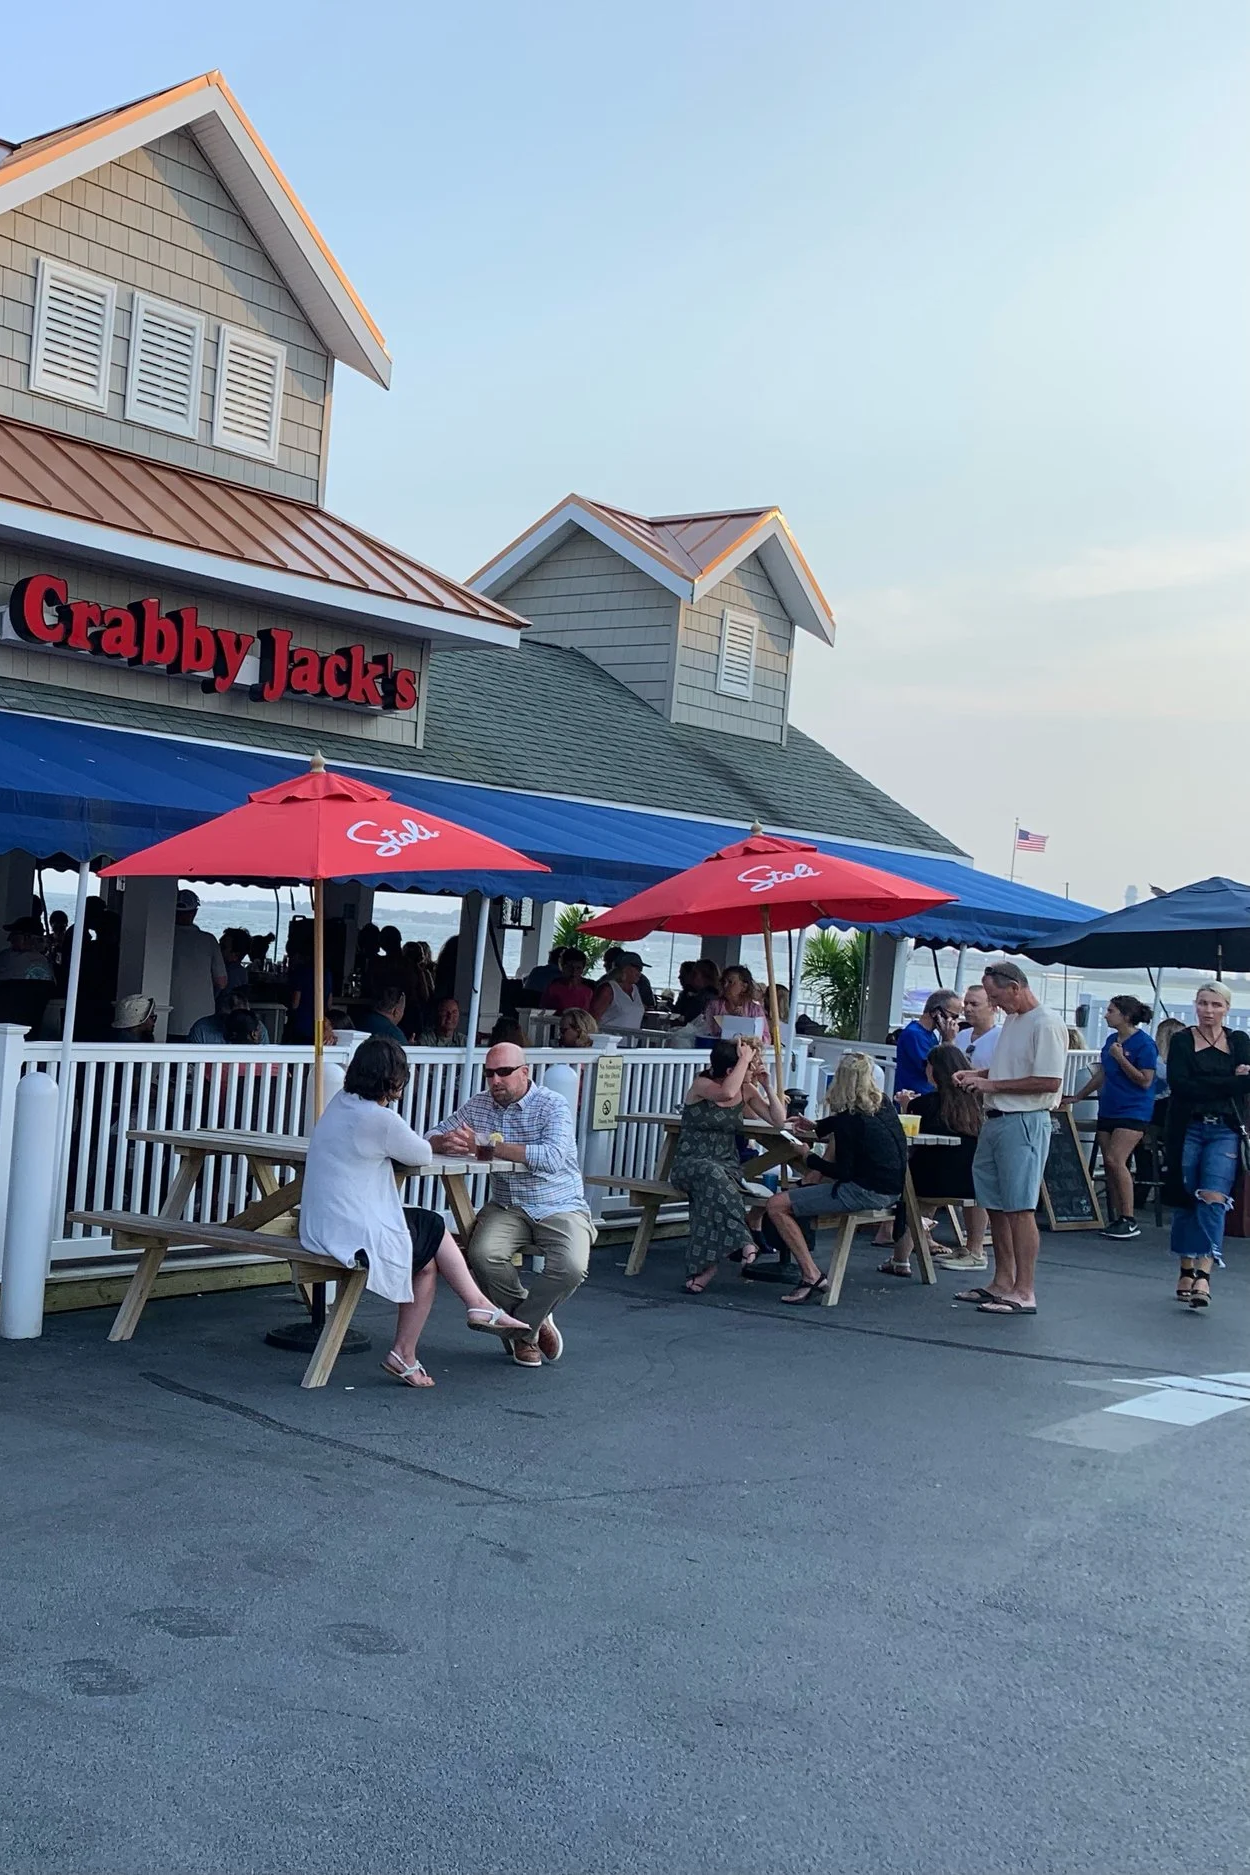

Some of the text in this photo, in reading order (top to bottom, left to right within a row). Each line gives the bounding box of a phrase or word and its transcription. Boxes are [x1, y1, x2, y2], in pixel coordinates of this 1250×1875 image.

[13, 573, 417, 711] Crabby Jack's
[346, 818, 441, 857] Stoli
[737, 863, 824, 893] Stoli
